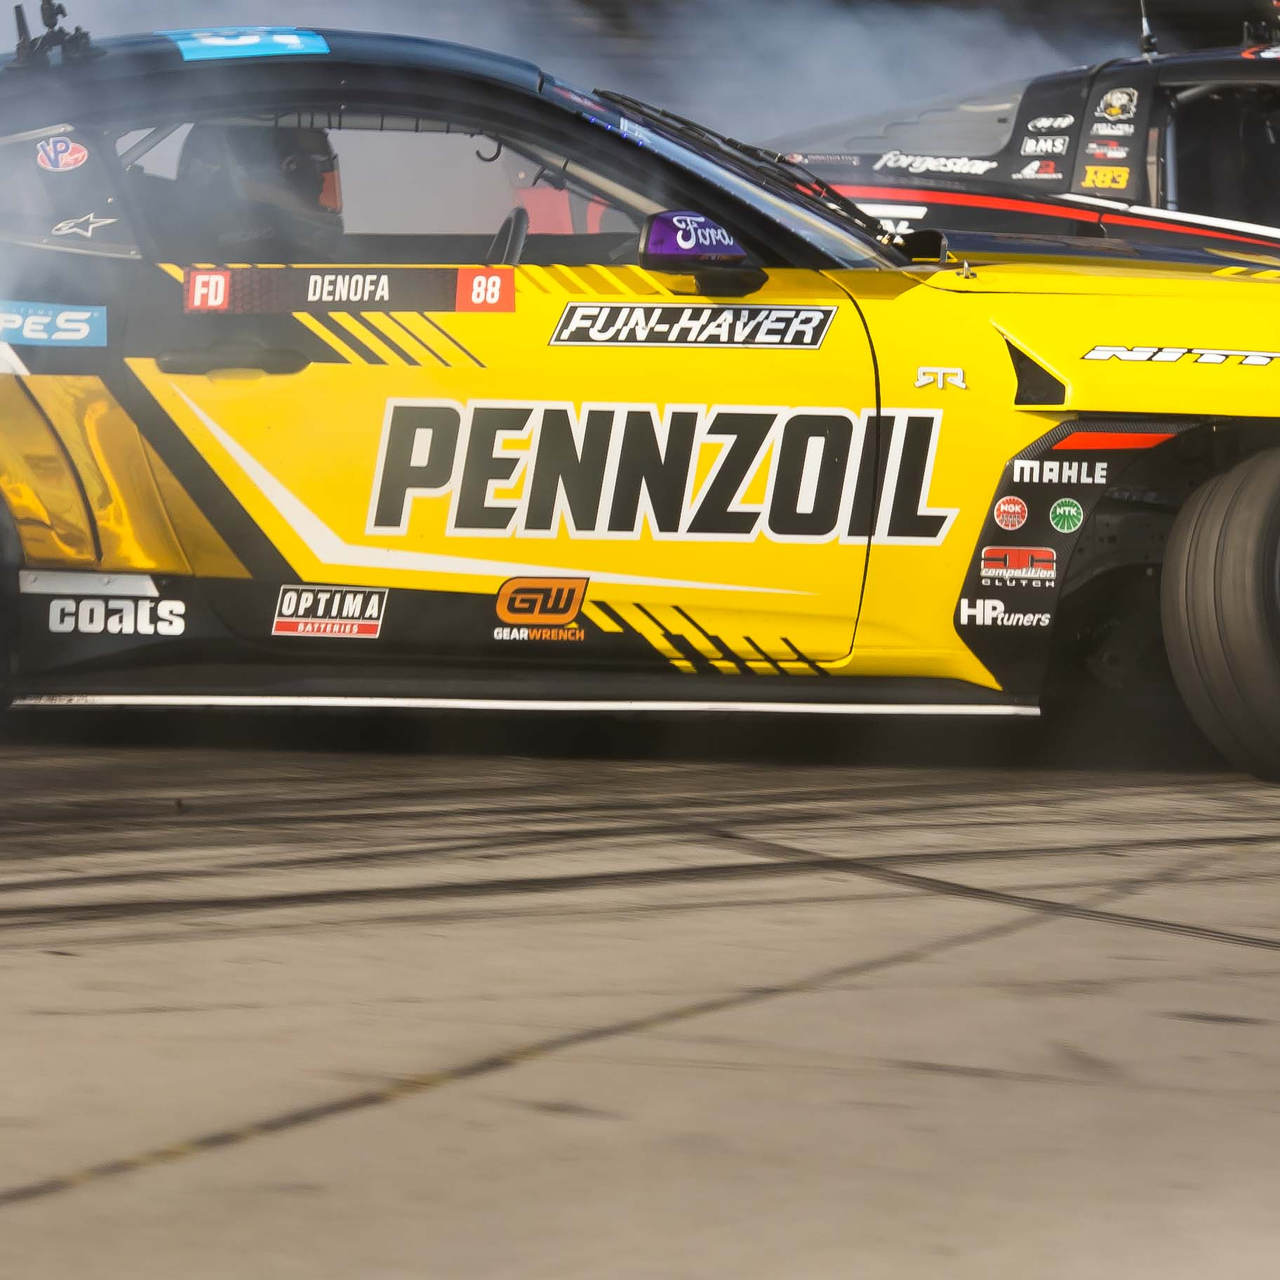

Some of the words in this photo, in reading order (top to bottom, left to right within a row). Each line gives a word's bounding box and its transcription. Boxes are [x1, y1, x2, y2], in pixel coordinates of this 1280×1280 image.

[672, 215, 734, 250] Ford
[193, 274, 226, 307] FD
[307, 274, 390, 303] DENOFA
[471, 275, 501, 305] 88
[559, 307, 825, 344] FUN-HAVER
[365, 398, 959, 545] PENNZOIL
[1013, 459, 1108, 484] MAHLE
[1056, 506, 1077, 516] NTK
[981, 567, 1056, 580] competition
[981, 579, 1055, 587] CLUTCH
[48, 598, 186, 636] coats
[281, 591, 380, 619] OPTIMA
[297, 622, 359, 634] BATTERIES
[493, 626, 585, 641] GEARWRENCH
